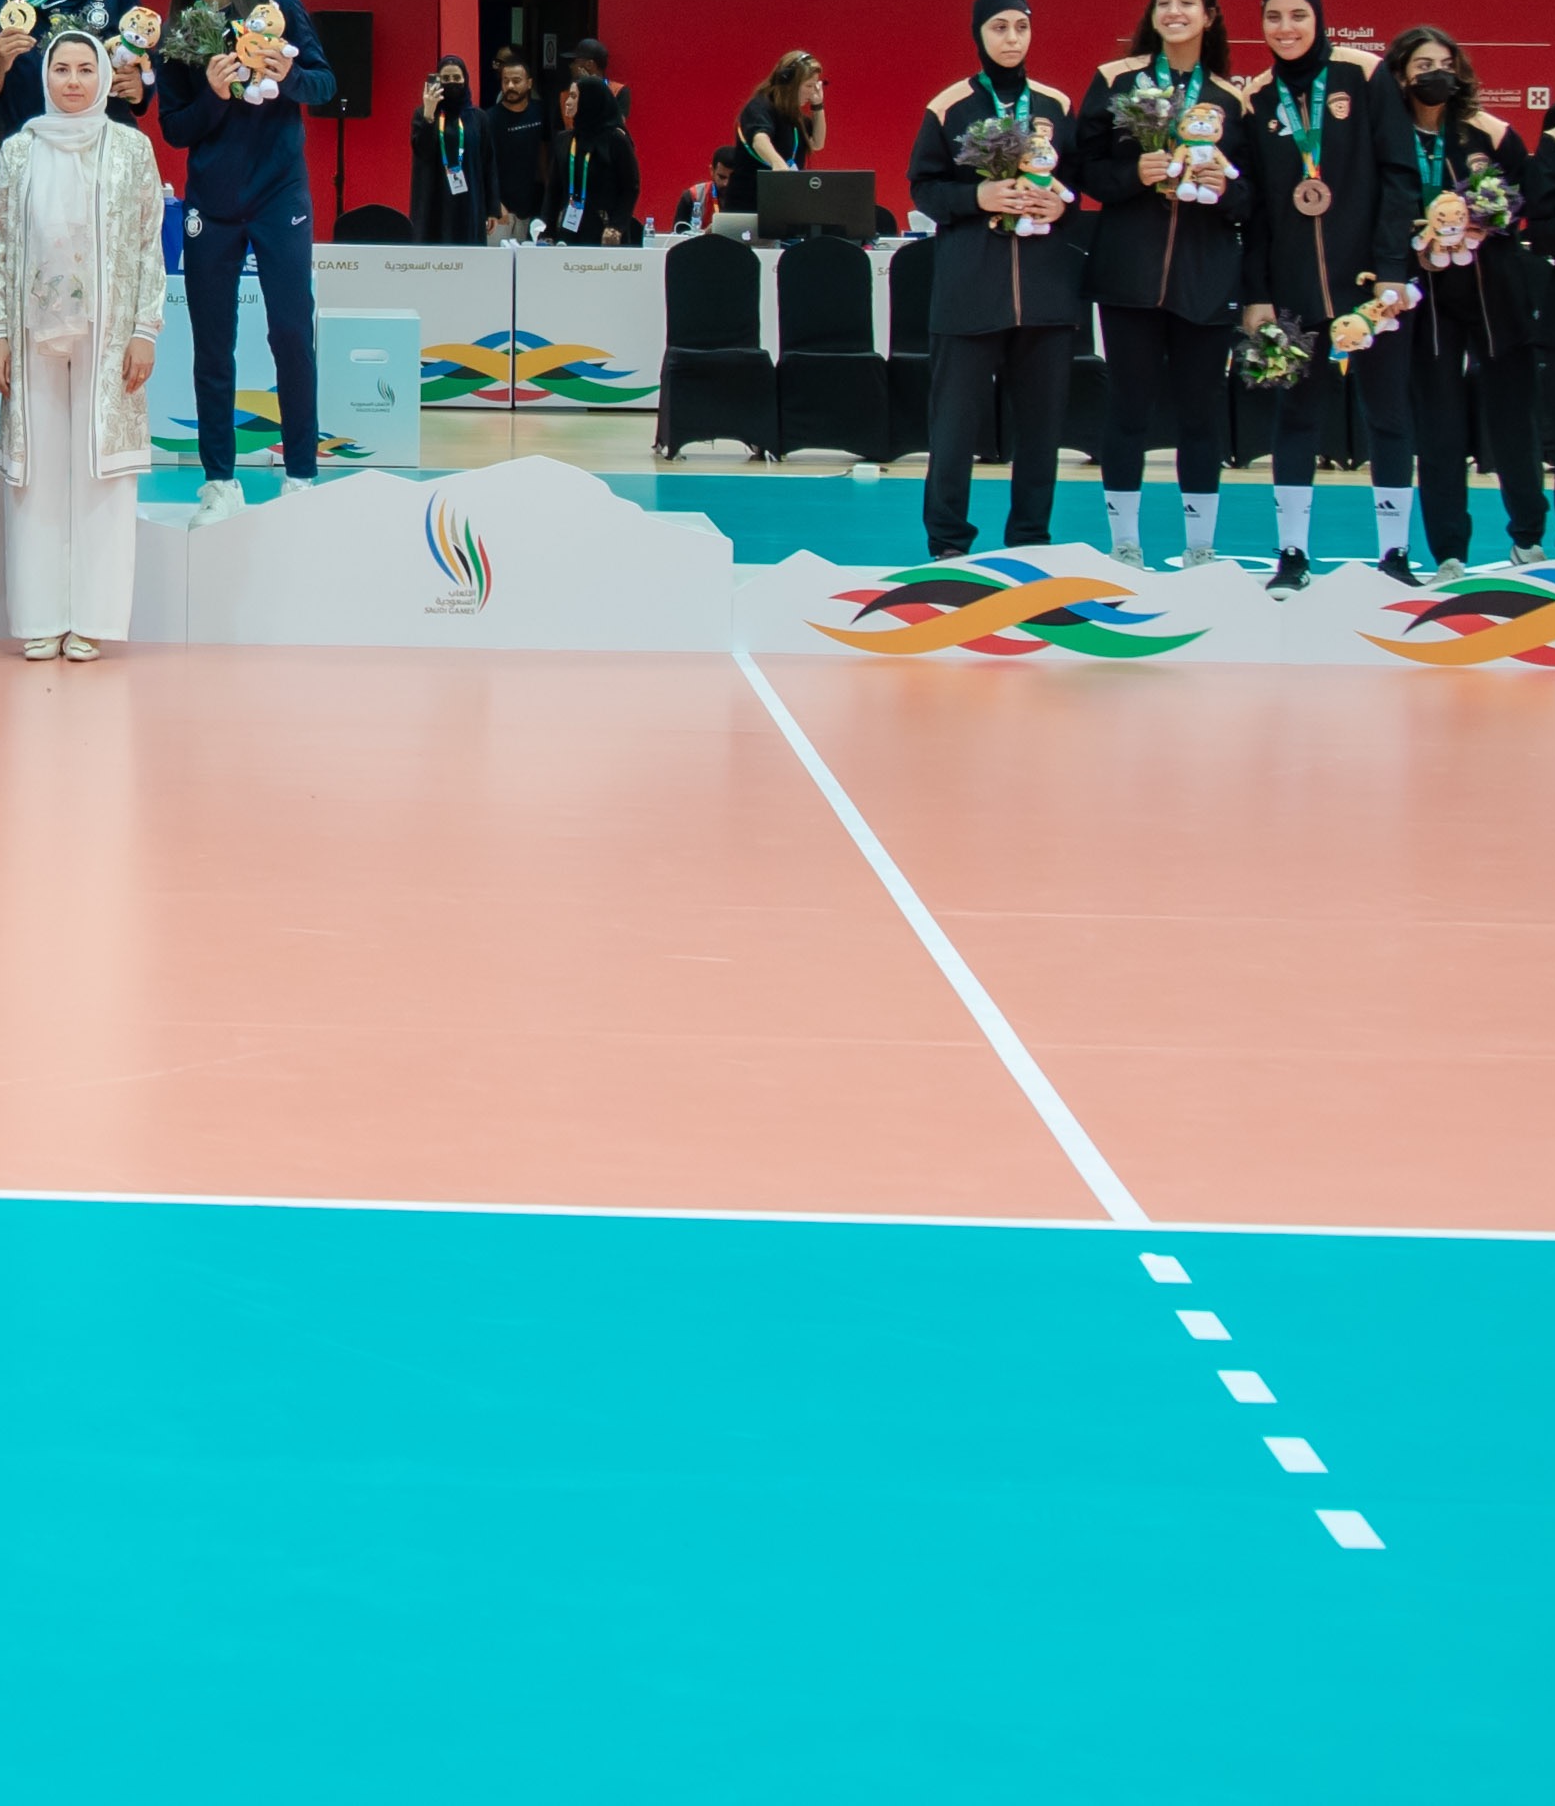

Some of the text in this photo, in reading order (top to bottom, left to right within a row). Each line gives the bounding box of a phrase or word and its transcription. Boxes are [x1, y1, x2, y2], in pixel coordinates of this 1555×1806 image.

[317, 261, 359, 270] GAMES
[384, 260, 430, 272] السعودية
[563, 262, 610, 273] السعودية
[448, 606, 476, 615] GAMES
